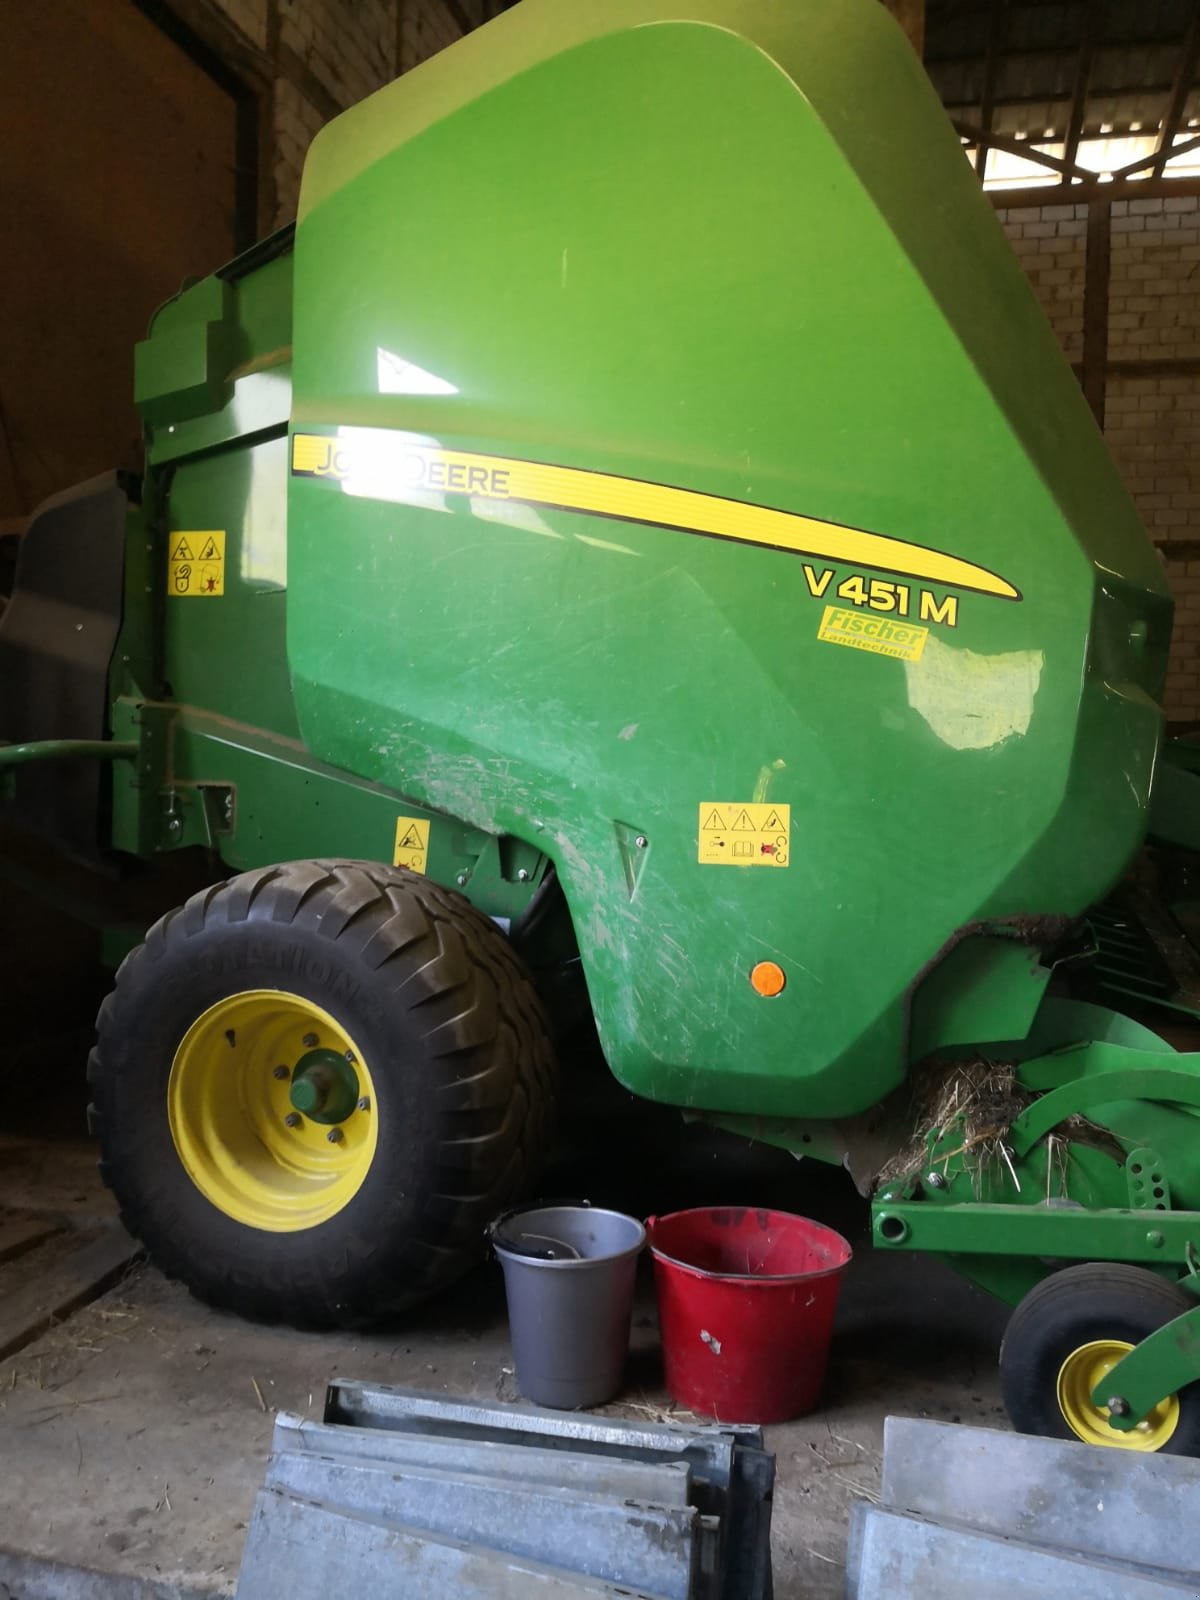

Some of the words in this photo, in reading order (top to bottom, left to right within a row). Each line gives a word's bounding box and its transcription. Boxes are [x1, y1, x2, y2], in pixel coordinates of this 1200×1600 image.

[801, 563, 835, 598] V
[836, 574, 911, 617] 451
[919, 589, 959, 628] M
[819, 630, 914, 660] Landtechnik
[827, 608, 923, 646] Fischer
